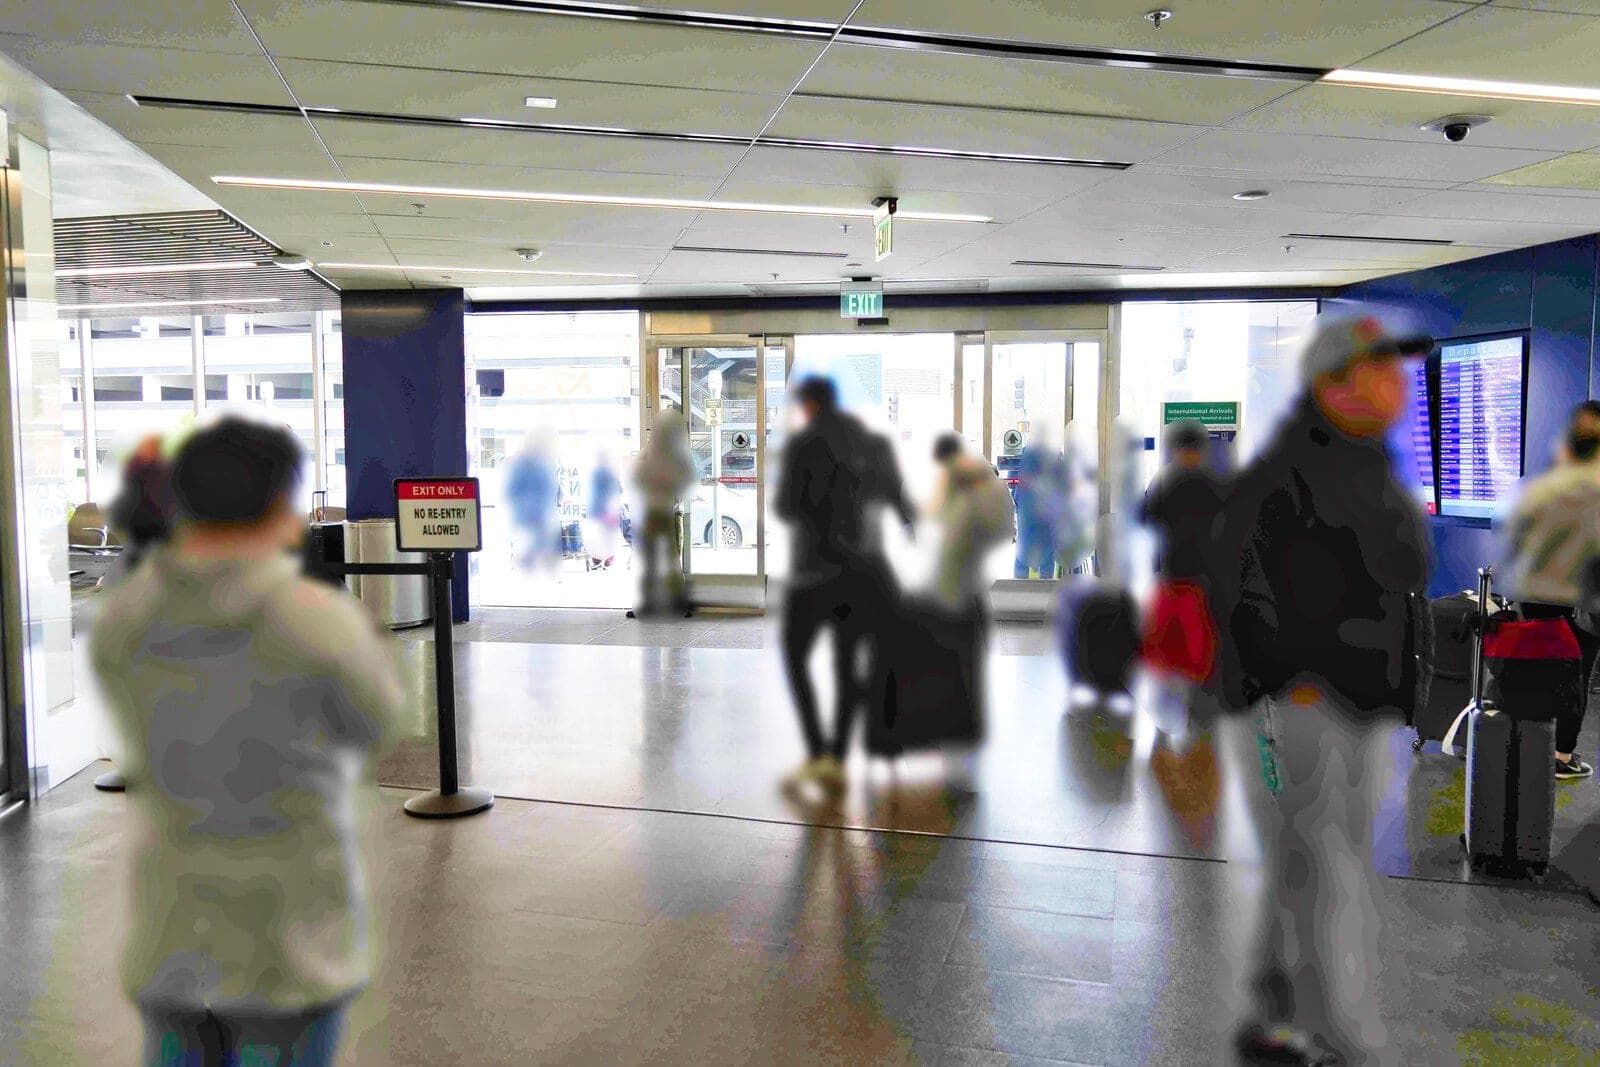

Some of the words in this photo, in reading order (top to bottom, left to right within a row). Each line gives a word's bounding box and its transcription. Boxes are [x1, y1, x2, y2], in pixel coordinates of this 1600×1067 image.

[848, 293, 877, 315] EXIT
[412, 486, 436, 496] EXIT
[437, 486, 465, 495] ONLY
[414, 508, 426, 519] NO
[427, 508, 467, 519] RE-ENTRY
[422, 525, 460, 535] ALLOWED
